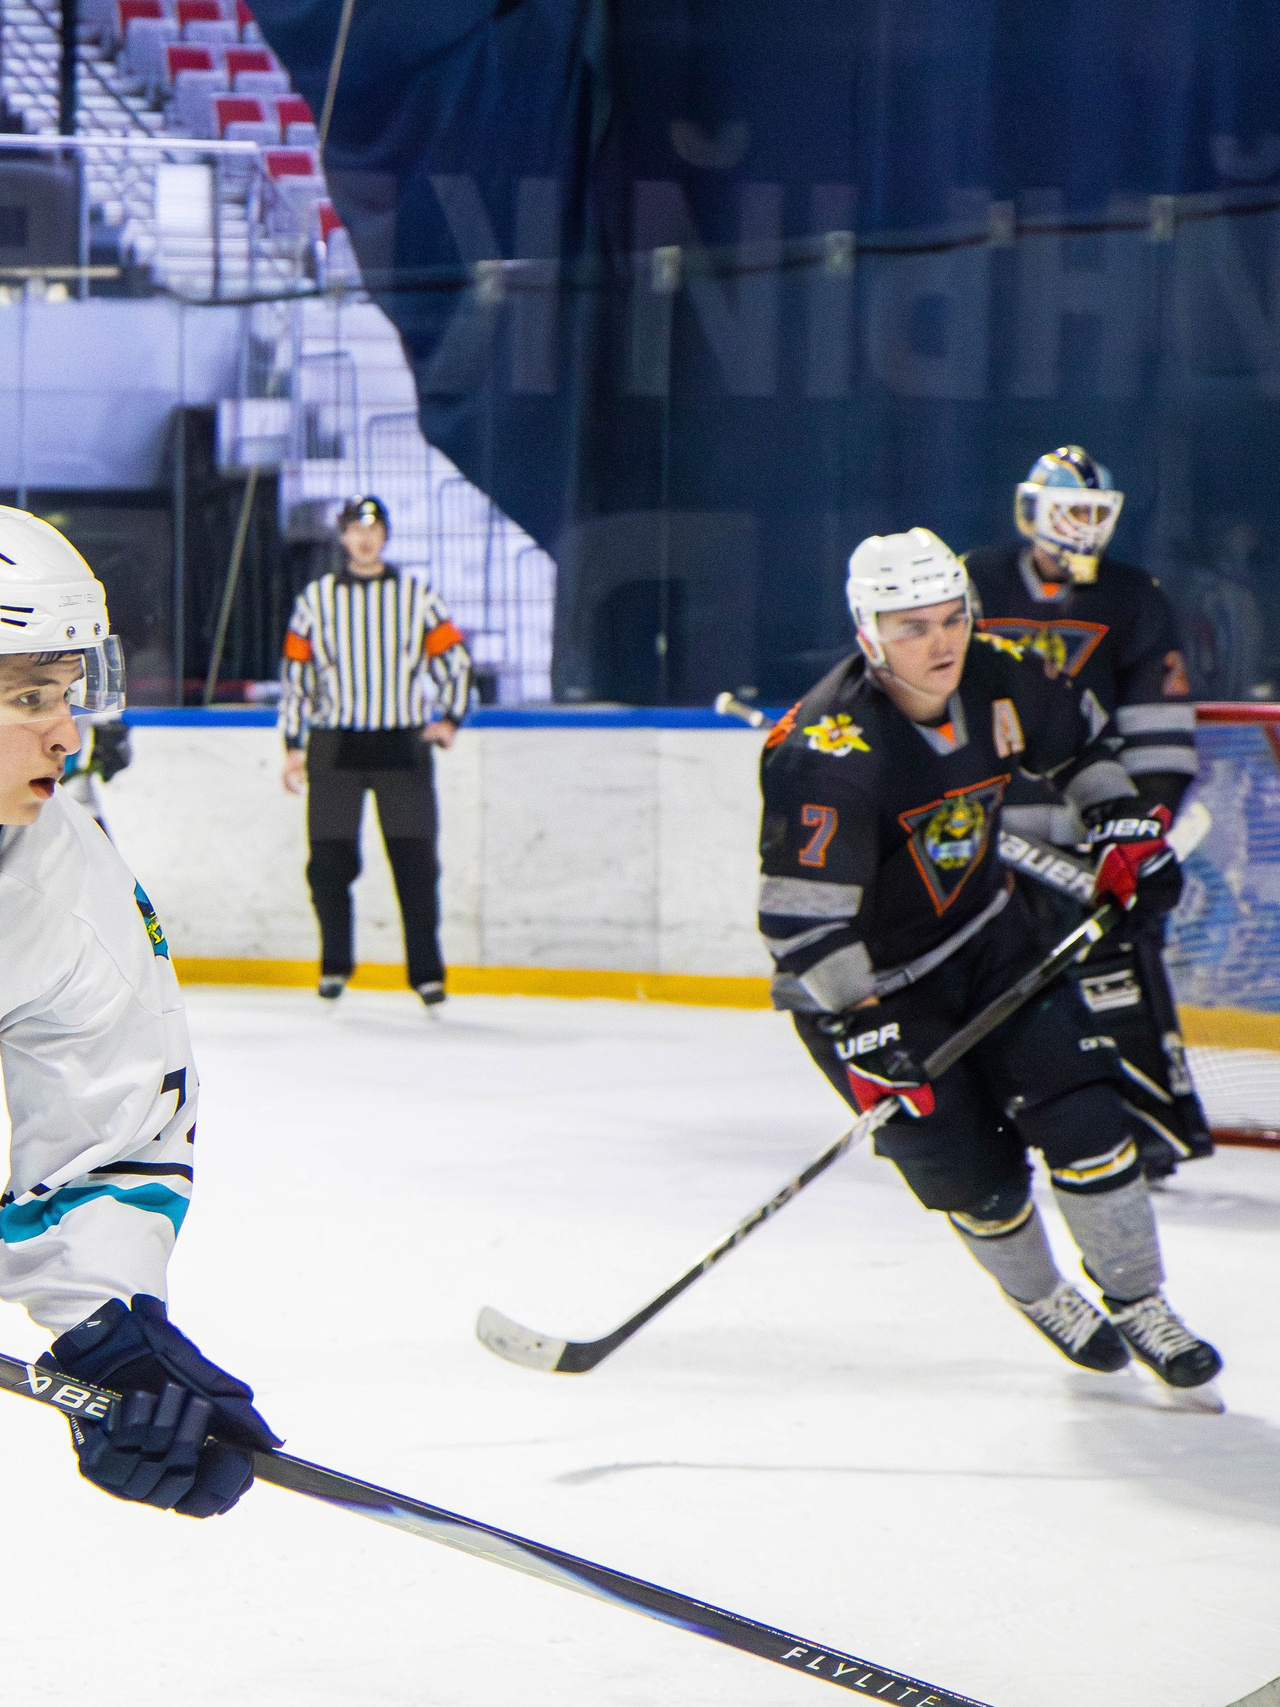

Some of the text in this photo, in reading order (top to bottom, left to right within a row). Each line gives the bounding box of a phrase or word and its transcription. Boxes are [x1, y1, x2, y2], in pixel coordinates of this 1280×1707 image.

[992, 698, 1026, 758] A
[798, 804, 838, 868] 7
[780, 1645, 941, 1707] FLYLITE
